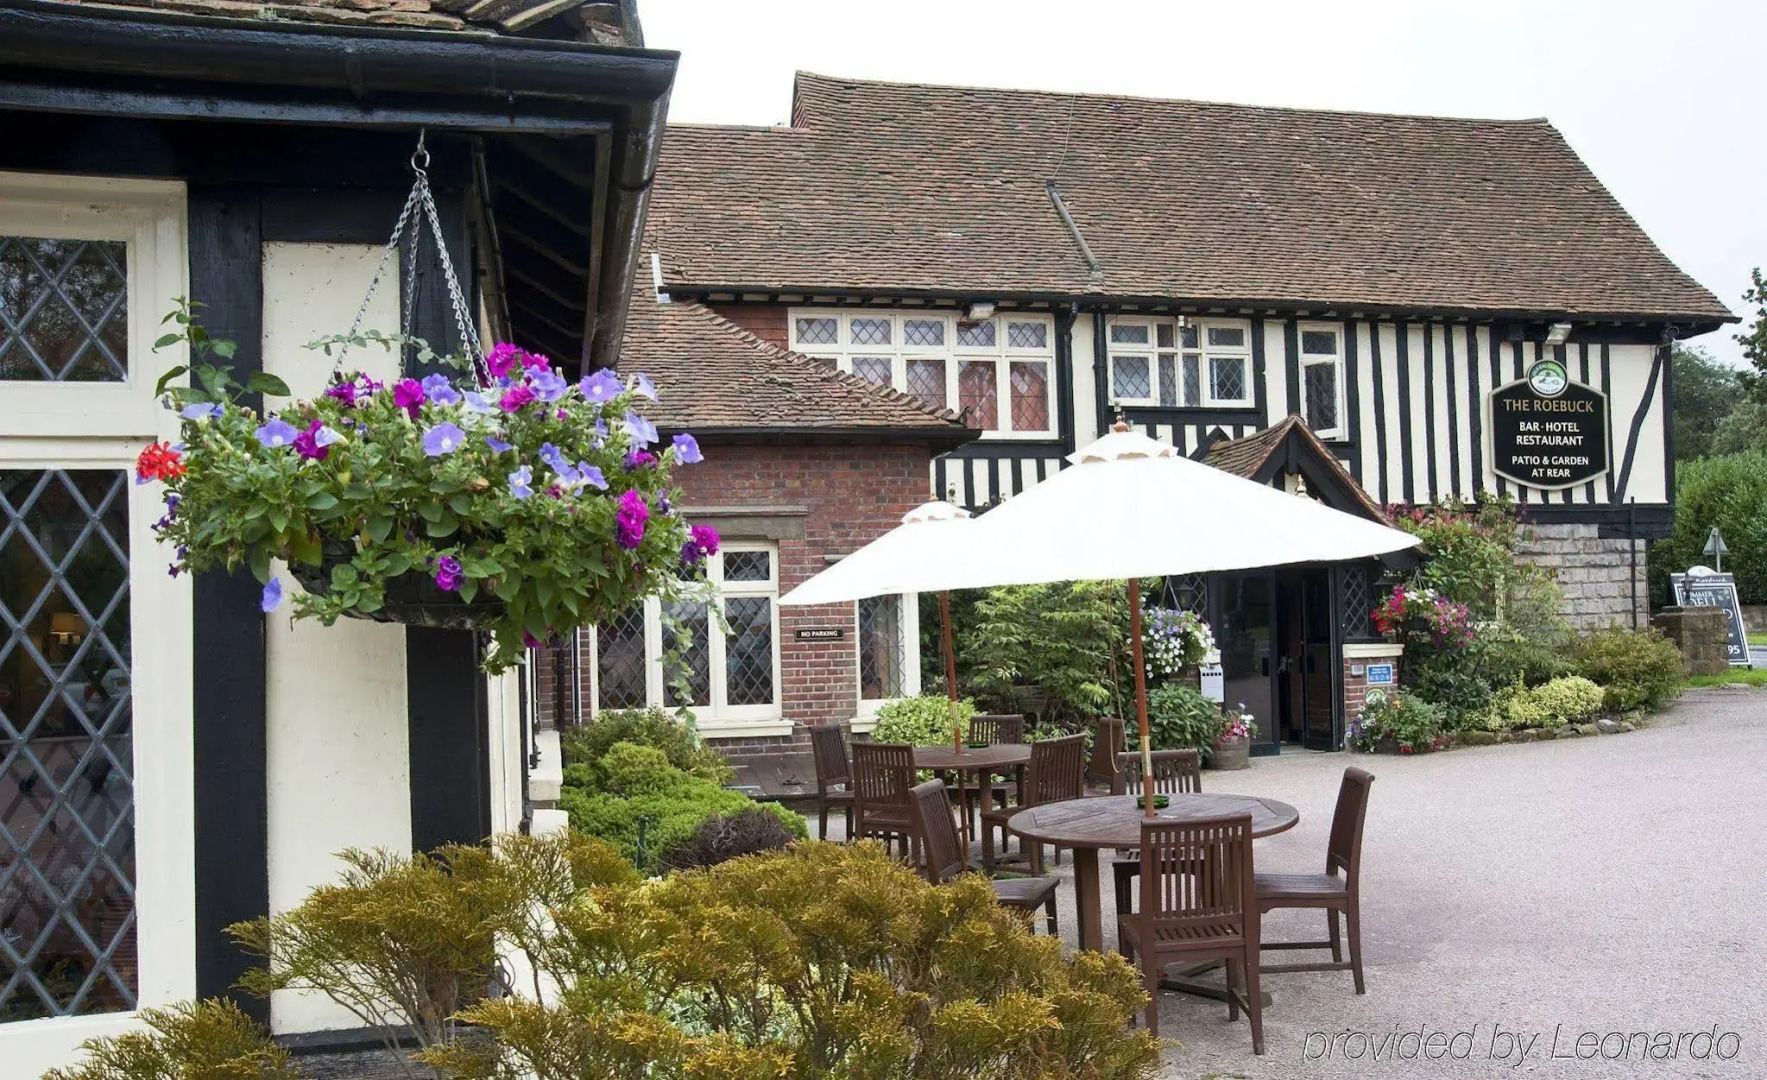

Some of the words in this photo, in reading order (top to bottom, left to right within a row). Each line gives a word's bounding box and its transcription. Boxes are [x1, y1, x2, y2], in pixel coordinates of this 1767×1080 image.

[1503, 399, 1530, 412] THE
[1533, 400, 1594, 413] ROEBUCK
[1519, 421, 1540, 432] BAR
[1545, 422, 1580, 433] HOTEL
[1516, 435, 1584, 446] RESTAURANT
[1511, 455, 1540, 465] PATIO
[1542, 456, 1549, 465] &
[1551, 456, 1589, 466] GARDEN
[1531, 468, 1544, 478] AT
[1546, 468, 1571, 478] REAR
